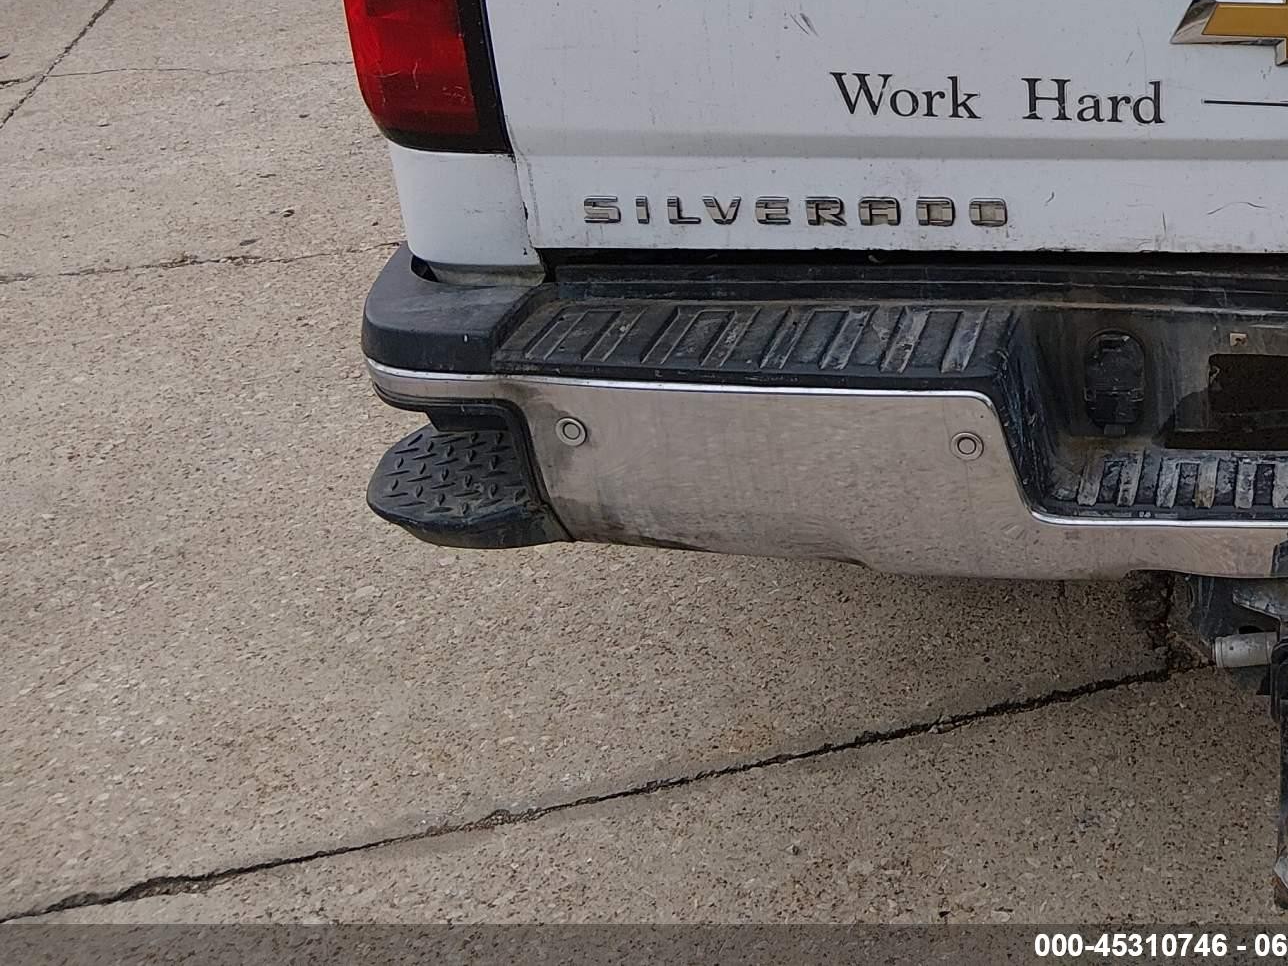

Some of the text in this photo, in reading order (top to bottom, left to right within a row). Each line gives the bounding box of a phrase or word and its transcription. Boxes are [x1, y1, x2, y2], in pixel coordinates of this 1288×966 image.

[829, 71, 982, 120] Work
[1021, 77, 1166, 125] Hard
[583, 195, 1009, 227] SILVERADO
